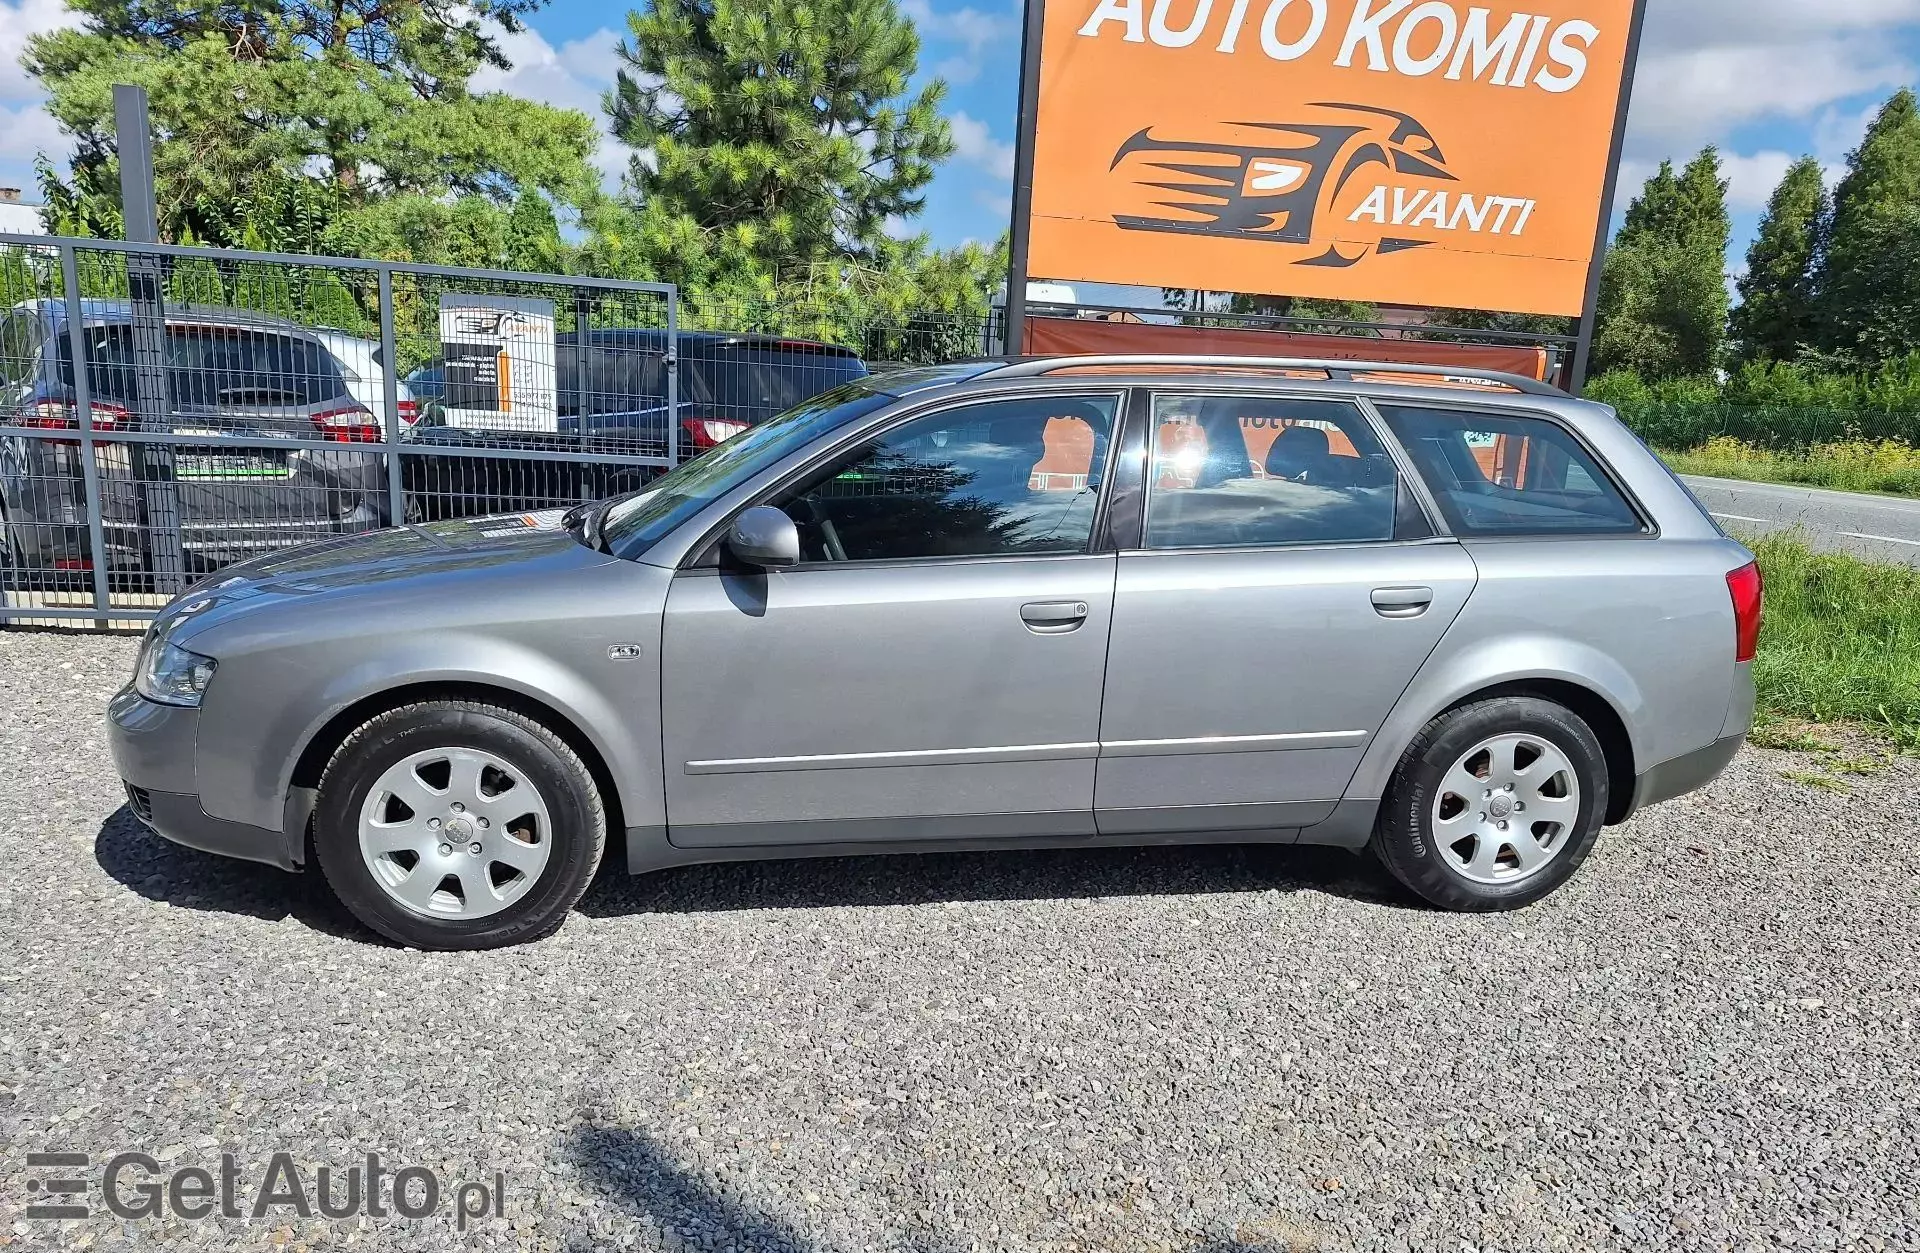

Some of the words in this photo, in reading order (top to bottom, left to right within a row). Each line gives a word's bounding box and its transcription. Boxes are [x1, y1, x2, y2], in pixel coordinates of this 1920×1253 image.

[1077, 0, 1328, 61] AUTO
[1333, 0, 1600, 93] KOMIS
[1346, 186, 1537, 235] AVANTI
